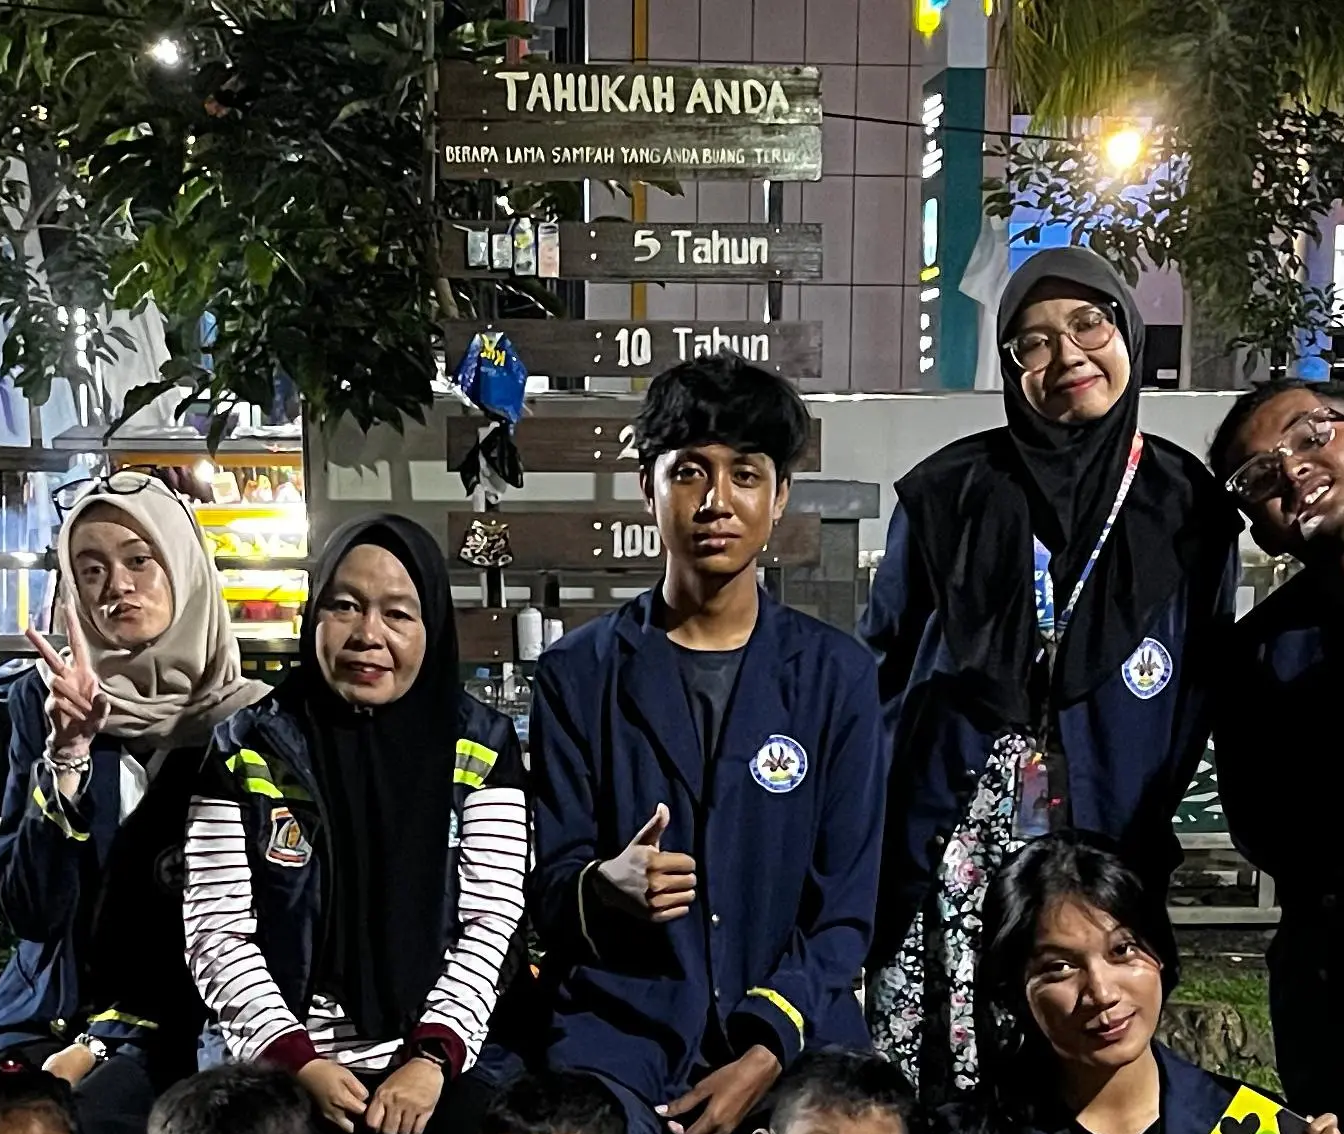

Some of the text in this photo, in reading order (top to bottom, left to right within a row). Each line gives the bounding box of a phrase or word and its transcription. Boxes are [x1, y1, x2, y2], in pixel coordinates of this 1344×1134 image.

[495, 71, 790, 116] TAHUKAH ANDA
[445, 146, 498, 163] BERAPA
[505, 146, 545, 164] LAMA
[551, 146, 614, 164] SAMPAH
[620, 146, 661, 164] YANG
[662, 147, 700, 164] ANDA
[702, 147, 745, 164] BUANG
[633, 229, 662, 262] 5
[670, 229, 769, 265] Tahun
[615, 327, 653, 367] 10
[672, 326, 770, 362] Tahun
[610, 521, 662, 558] 100
